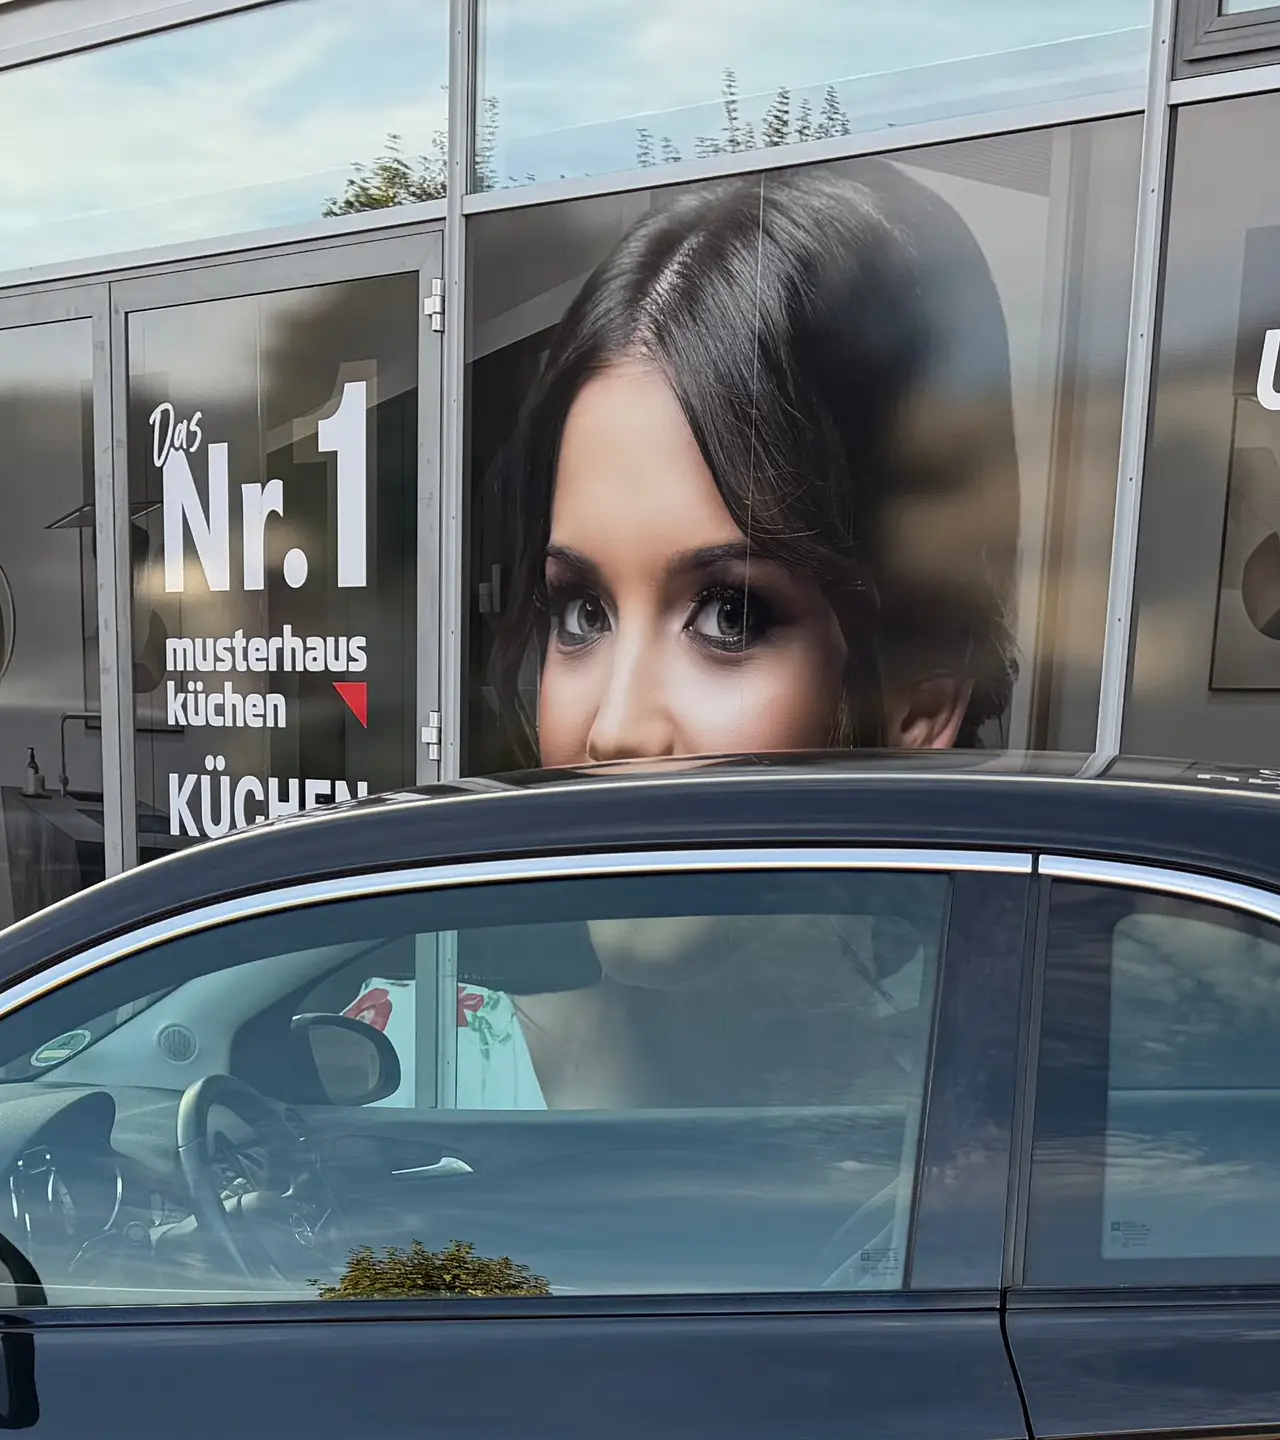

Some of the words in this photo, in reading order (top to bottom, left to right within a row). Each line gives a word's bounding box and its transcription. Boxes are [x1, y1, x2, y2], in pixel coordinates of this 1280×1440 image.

[149, 401, 203, 468] Das
[165, 624, 368, 672] musterhaus
[166, 680, 287, 728] küchen
[168, 754, 369, 839] KÜCH
